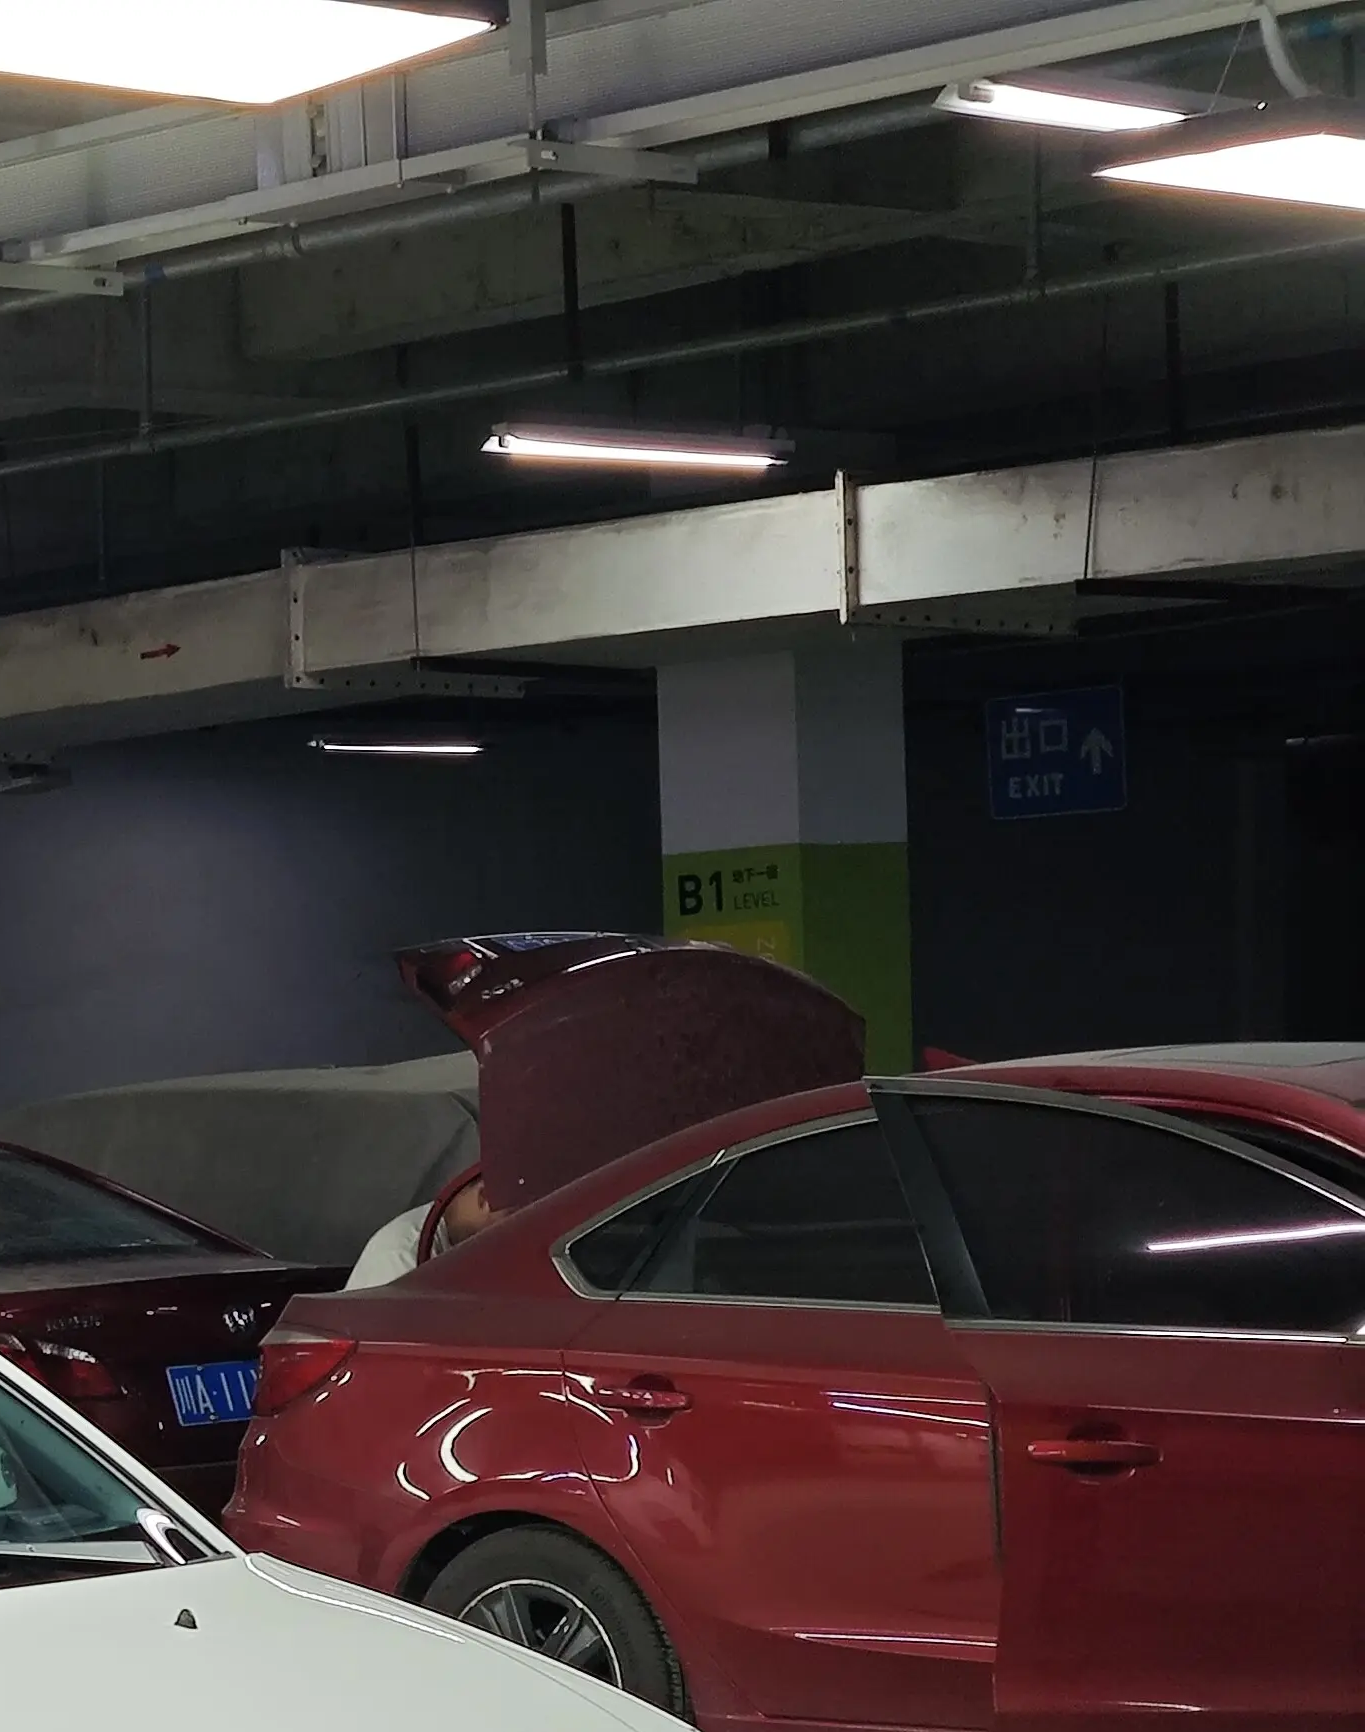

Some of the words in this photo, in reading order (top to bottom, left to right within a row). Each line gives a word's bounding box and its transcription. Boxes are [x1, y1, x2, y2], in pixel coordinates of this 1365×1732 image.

[1001, 716, 1069, 761] 出口
[1008, 772, 1065, 799] EXIT
[678, 871, 724, 916] B1
[733, 889, 781, 911] LEVEL
